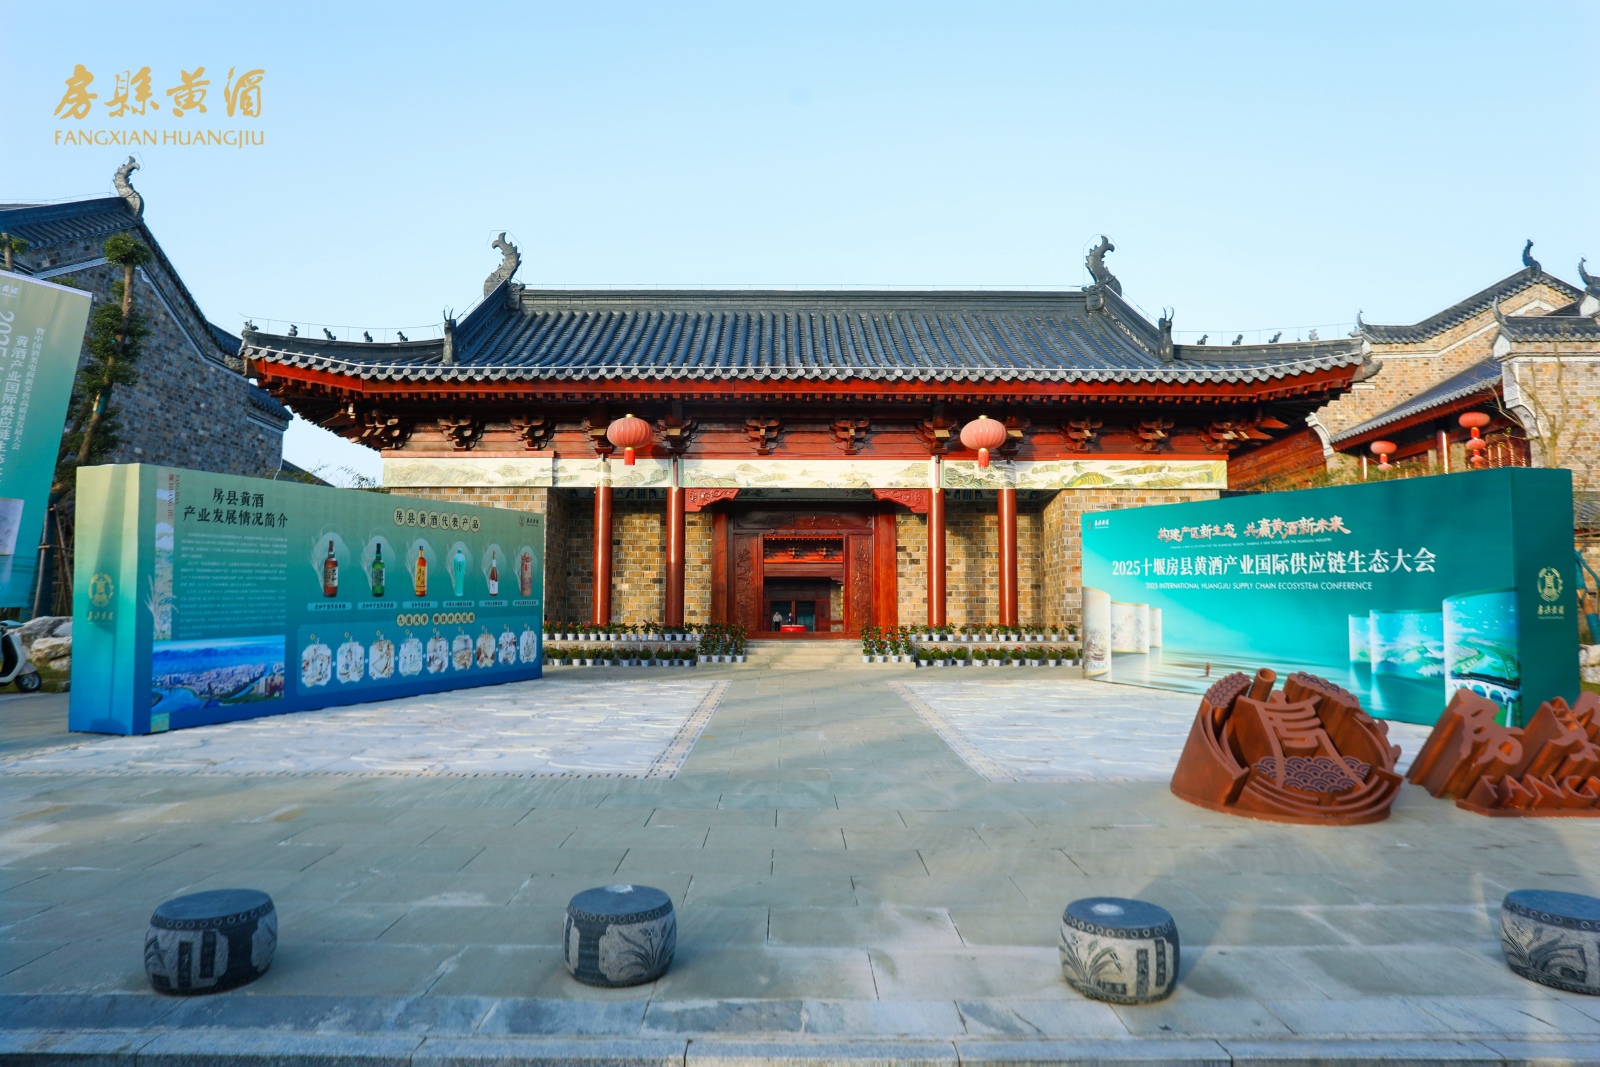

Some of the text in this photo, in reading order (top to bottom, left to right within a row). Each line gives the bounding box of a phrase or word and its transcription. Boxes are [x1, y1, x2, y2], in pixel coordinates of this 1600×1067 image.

[212, 488, 264, 509] 房县黄酒
[183, 505, 289, 528] 产业发展情况简介
[396, 511, 479, 529] 房县黄酒代表产品
[1157, 515, 1352, 543] 构建产区新生态 共赢黄酒新未来
[1112, 546, 1437, 577] 2025十堰房县黄酒产业国际供应链生态大会
[1146, 581, 1373, 590] 2025 INTERNATIONAL HUANGJIU SUPPLY CHAIN ECOSYSTEM CONFERENCE
